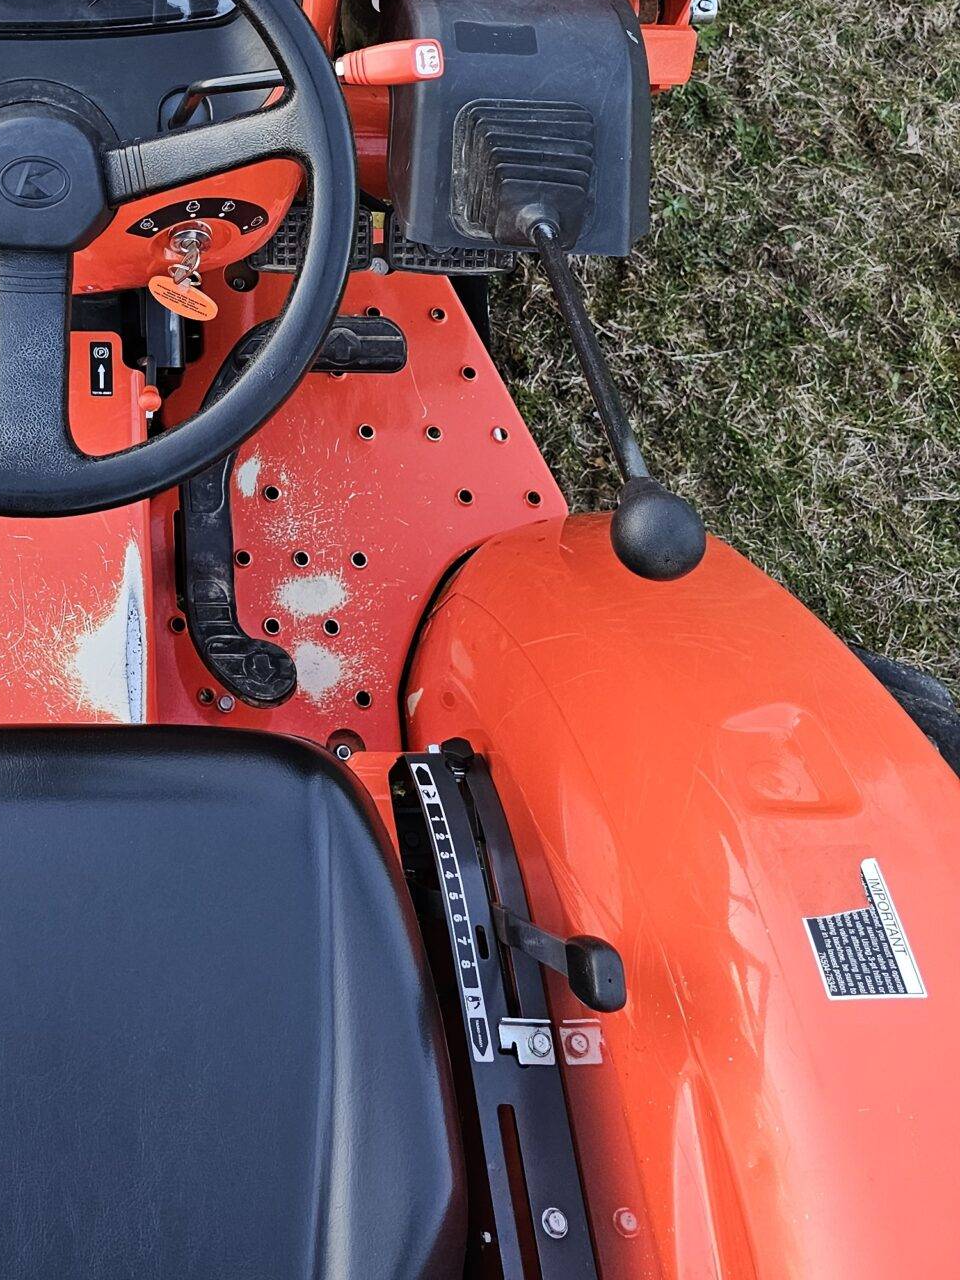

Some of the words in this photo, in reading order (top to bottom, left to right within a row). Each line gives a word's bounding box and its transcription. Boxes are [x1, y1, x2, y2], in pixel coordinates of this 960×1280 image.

[867, 878, 907, 955] IMPORTANT
[849, 935, 866, 960] attached
[864, 926, 881, 951] auxiliary
[826, 949, 840, 967] lowest
[842, 946, 860, 972] resulting
[856, 981, 867, 993] seal
[859, 938, 873, 955] Using
[872, 970, 884, 985] hitch
[859, 962, 870, 973] will
[875, 929, 886, 940] you
[881, 942, 892, 957] must
[890, 970, 905, 992] operate
[875, 953, 888, 970] valve
[843, 972, 854, 986] sure
[863, 975, 876, 993] cause
[881, 972, 896, 993] placed
